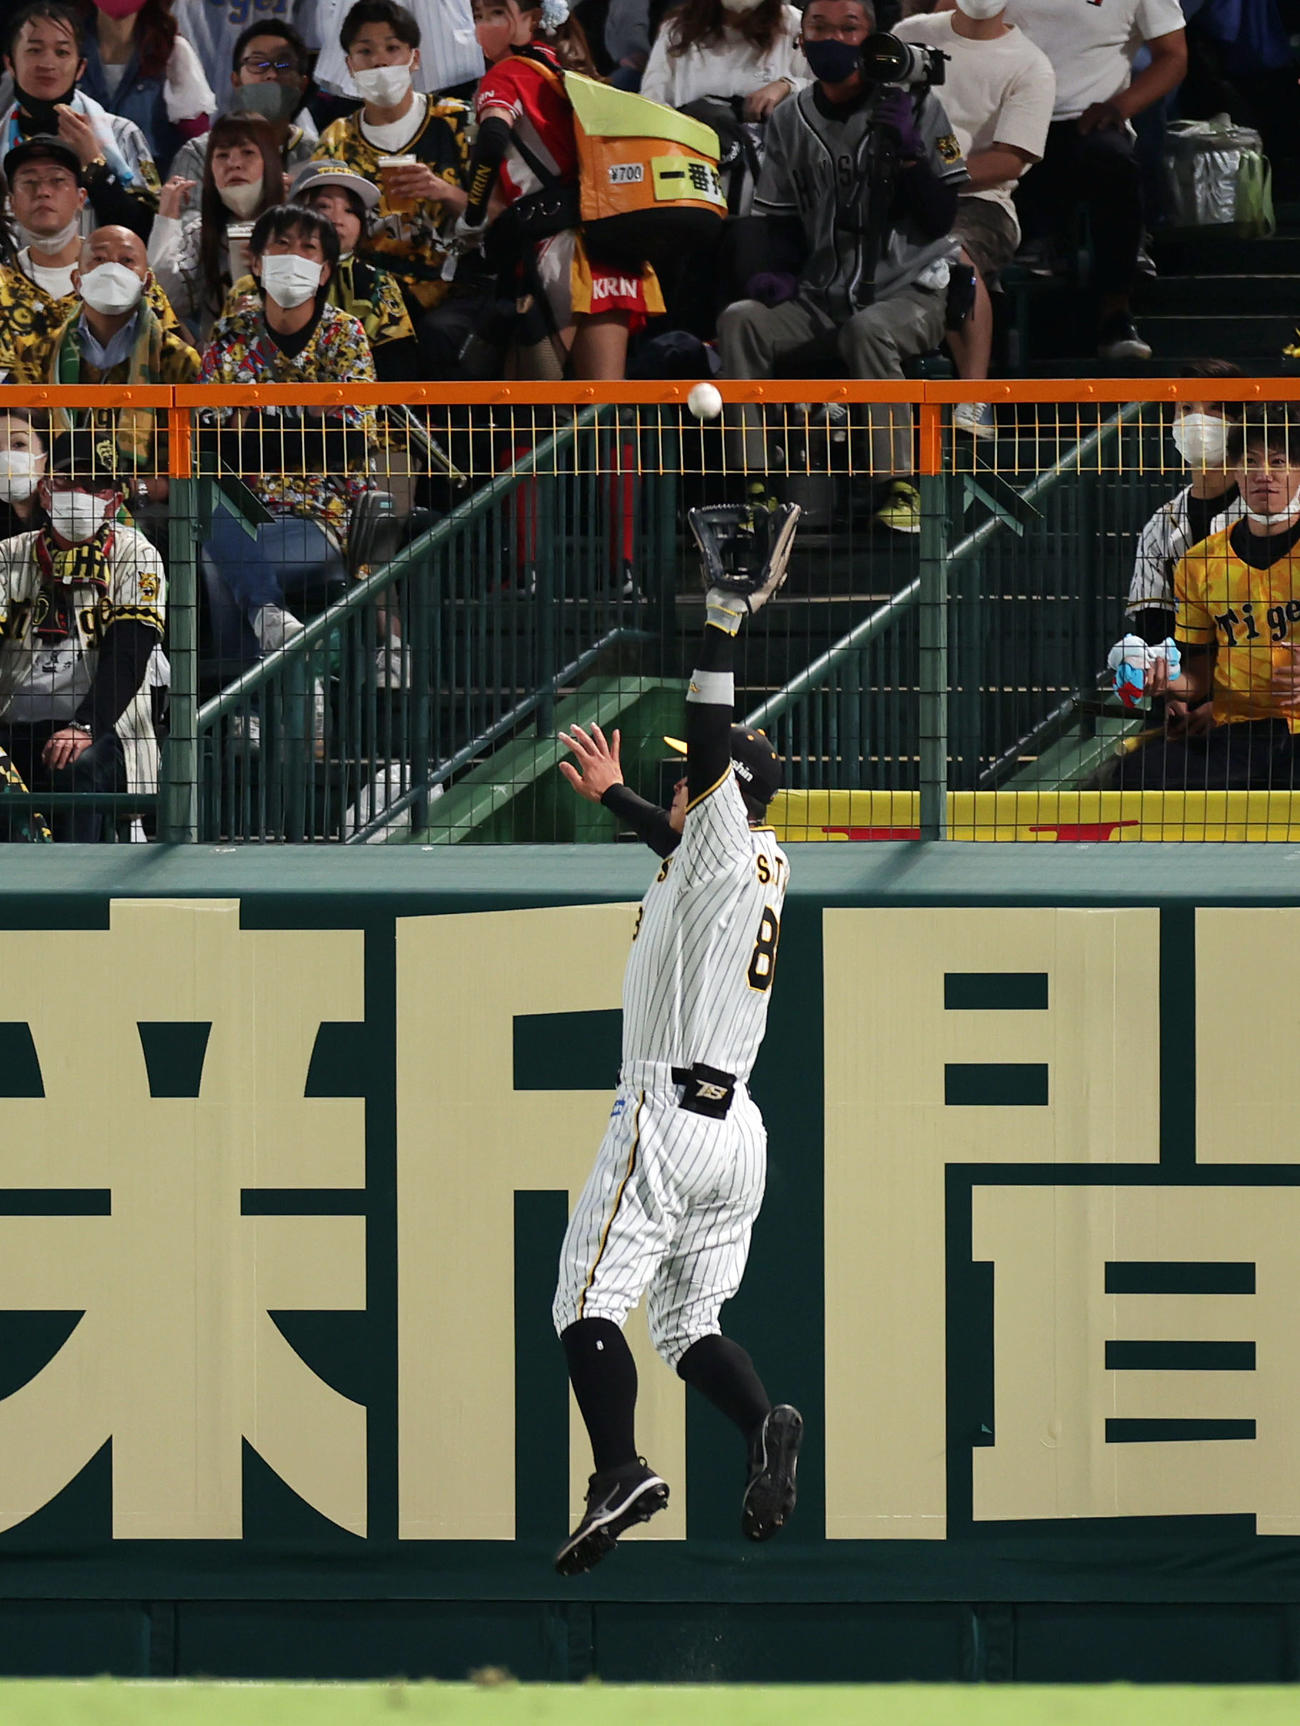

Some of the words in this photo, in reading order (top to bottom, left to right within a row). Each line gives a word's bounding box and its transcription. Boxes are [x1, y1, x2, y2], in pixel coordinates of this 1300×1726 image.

[468, 164, 492, 205] KIRIN
[611, 166, 642, 182] ¥700
[1214, 600, 1300, 647] Tige
[746, 904, 781, 992] 8
[696, 1080, 728, 1100] TS
[0, 898, 1300, 1540] 新聞
